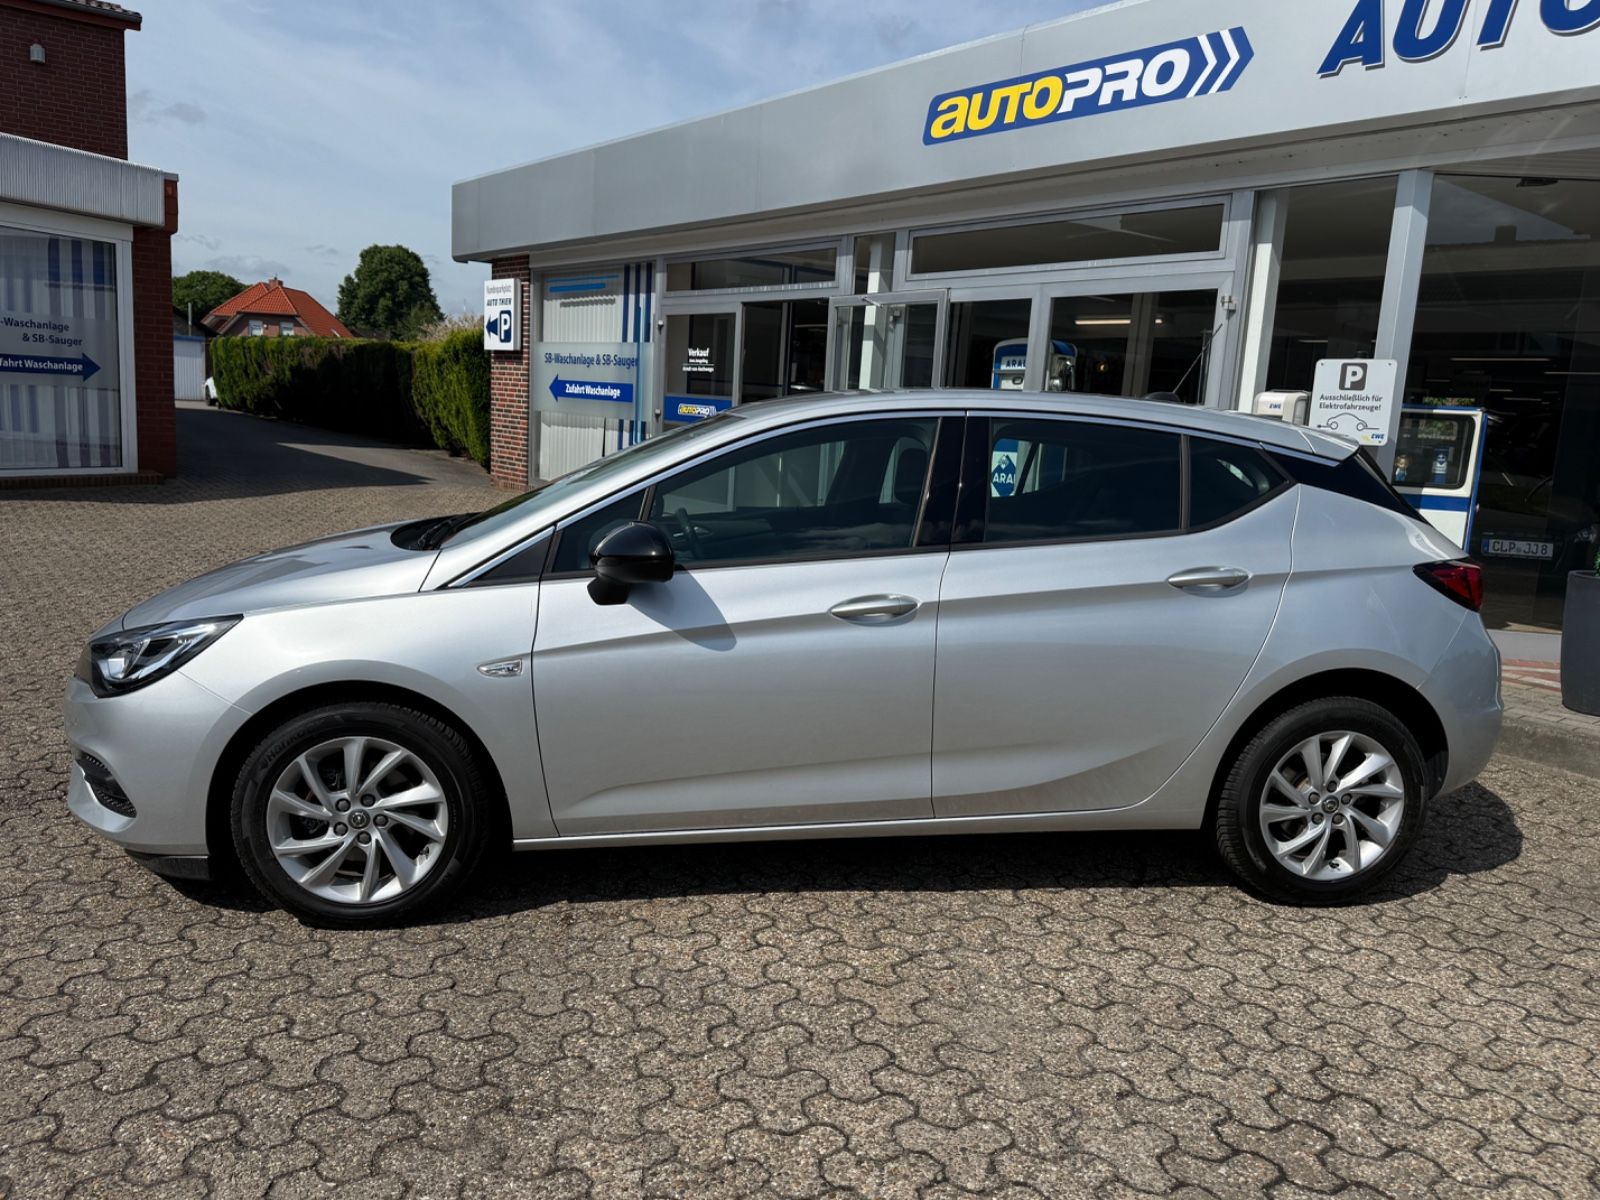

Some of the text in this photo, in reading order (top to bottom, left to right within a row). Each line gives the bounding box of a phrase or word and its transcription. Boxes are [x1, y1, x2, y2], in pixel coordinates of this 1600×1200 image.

[501, 313, 511, 340] P
[22, 333, 83, 347] & SB-Sauger
[688, 347, 710, 357] Verkauf
[24, 359, 84, 373] Waschanlage
[544, 352, 638, 370] SB-Waschanlage & SB-Sauger
[1344, 365, 1364, 389] P
[565, 383, 621, 399] Zufahrt Waschanlage
[1319, 393, 1383, 402] Ausschließlich für
[1319, 401, 1381, 412] Elektrofahrzeuge!
[1492, 541, 1516, 553] CLP
